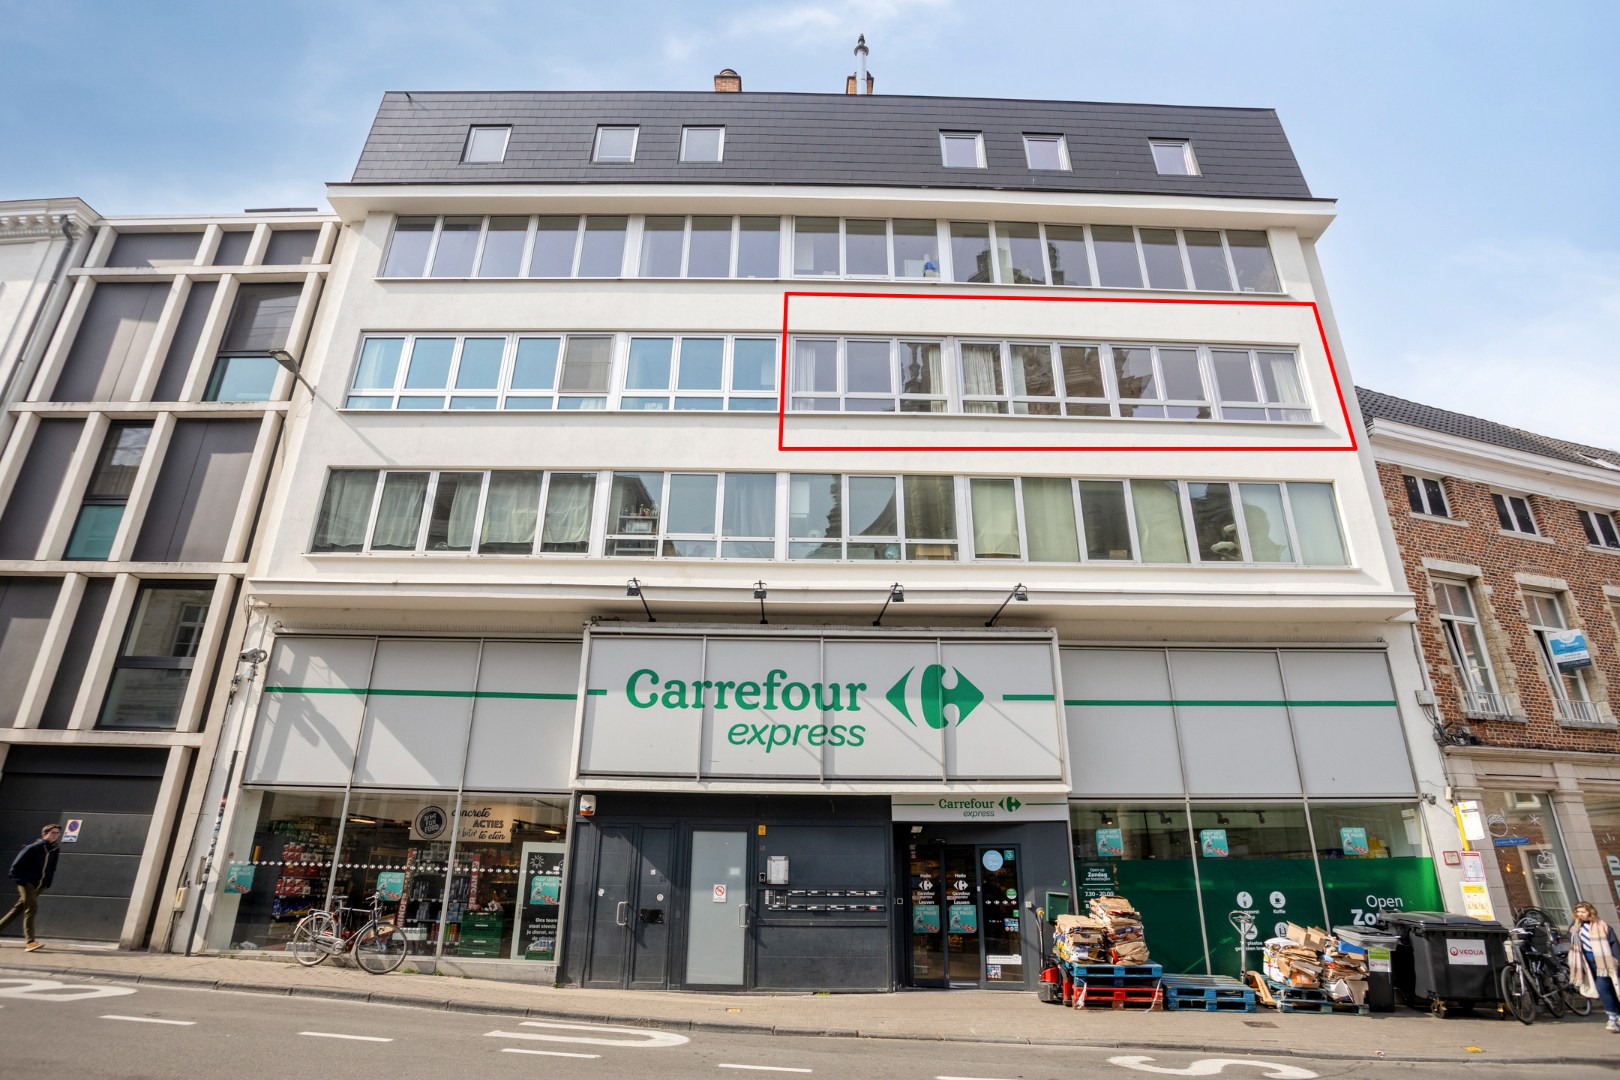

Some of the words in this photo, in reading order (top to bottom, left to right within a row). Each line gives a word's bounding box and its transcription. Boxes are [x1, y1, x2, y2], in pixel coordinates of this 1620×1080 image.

[626, 669, 866, 712] Carrefour
[728, 722, 866, 753] express
[939, 798, 995, 809] Carrefour
[451, 807, 491, 818] cncrete
[963, 810, 995, 818] express
[472, 819, 504, 829] ACTIES
[1366, 895, 1403, 911] Open
[1351, 909, 1381, 925] Zo
